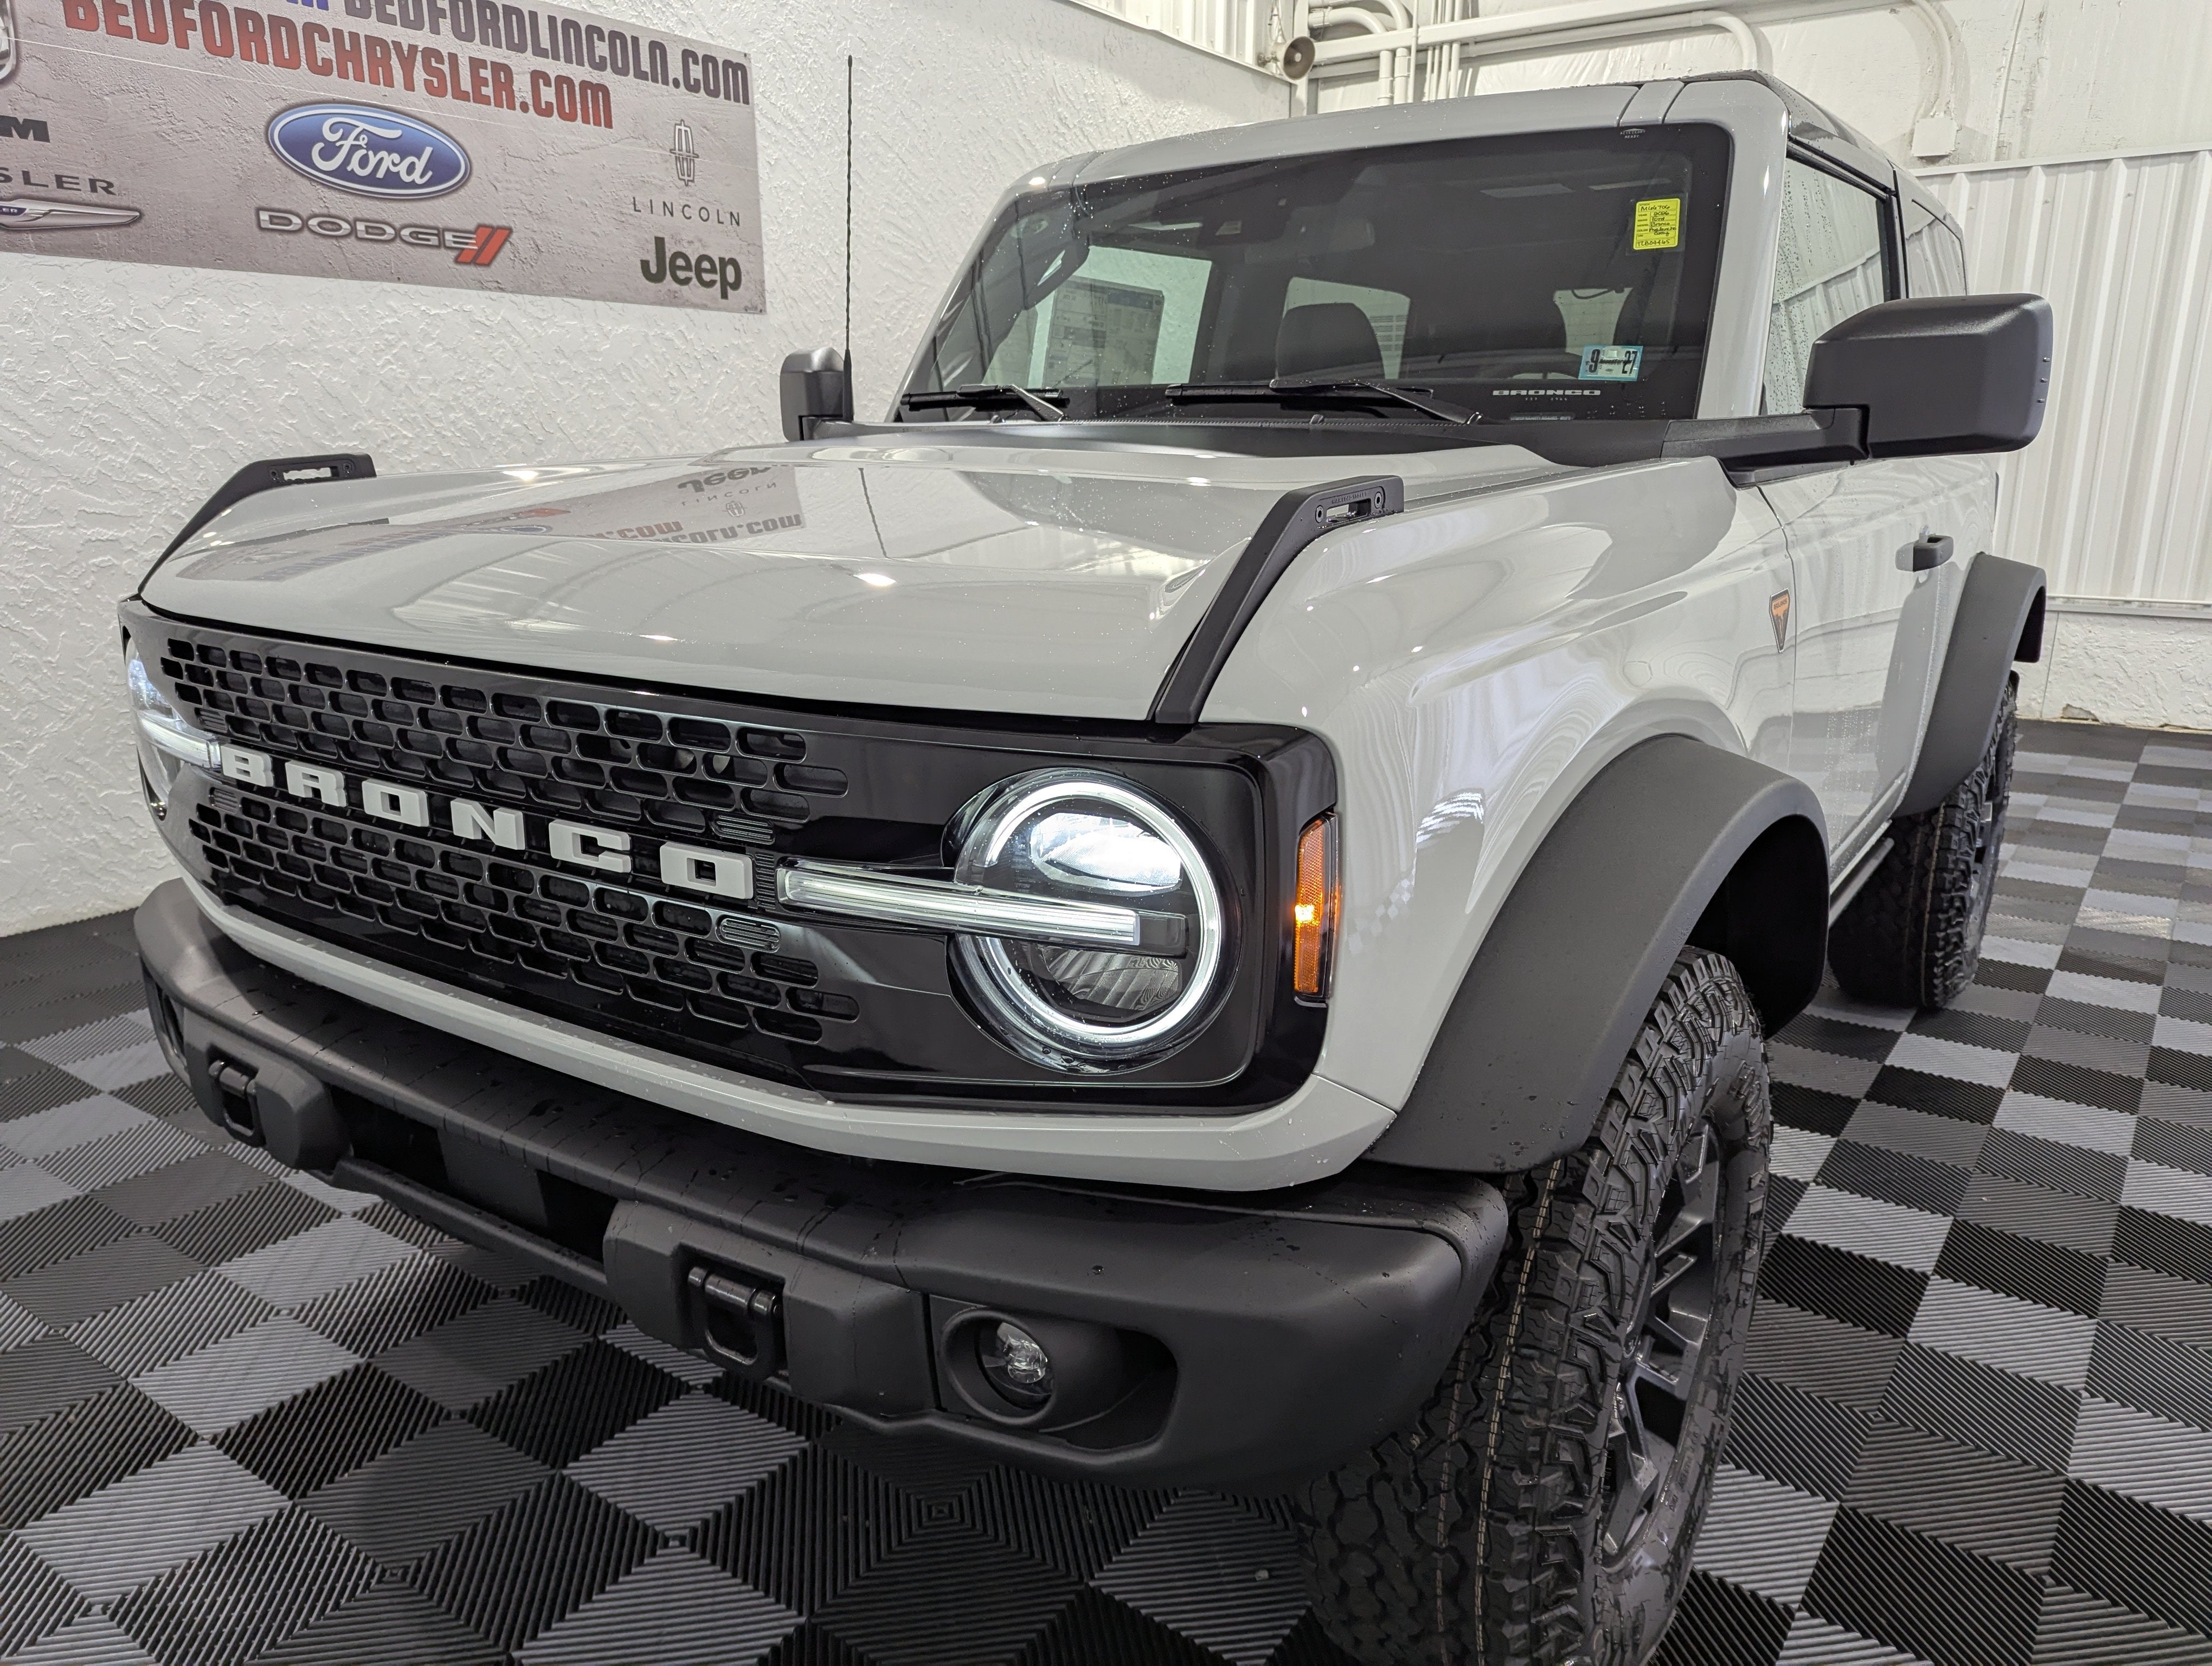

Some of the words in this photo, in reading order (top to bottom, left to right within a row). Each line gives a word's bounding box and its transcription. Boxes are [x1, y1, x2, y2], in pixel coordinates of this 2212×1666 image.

[62, 0, 613, 129] BEDFORDCHRYSLER.COM
[312, 117, 434, 184] Ford
[259, 210, 478, 250] DODGE
[633, 197, 740, 227] LINCOLN
[640, 236, 742, 300] Jeep
[1589, 349, 1600, 373] 9
[1622, 350, 1638, 374] 27
[220, 744, 754, 900] BRONCO
